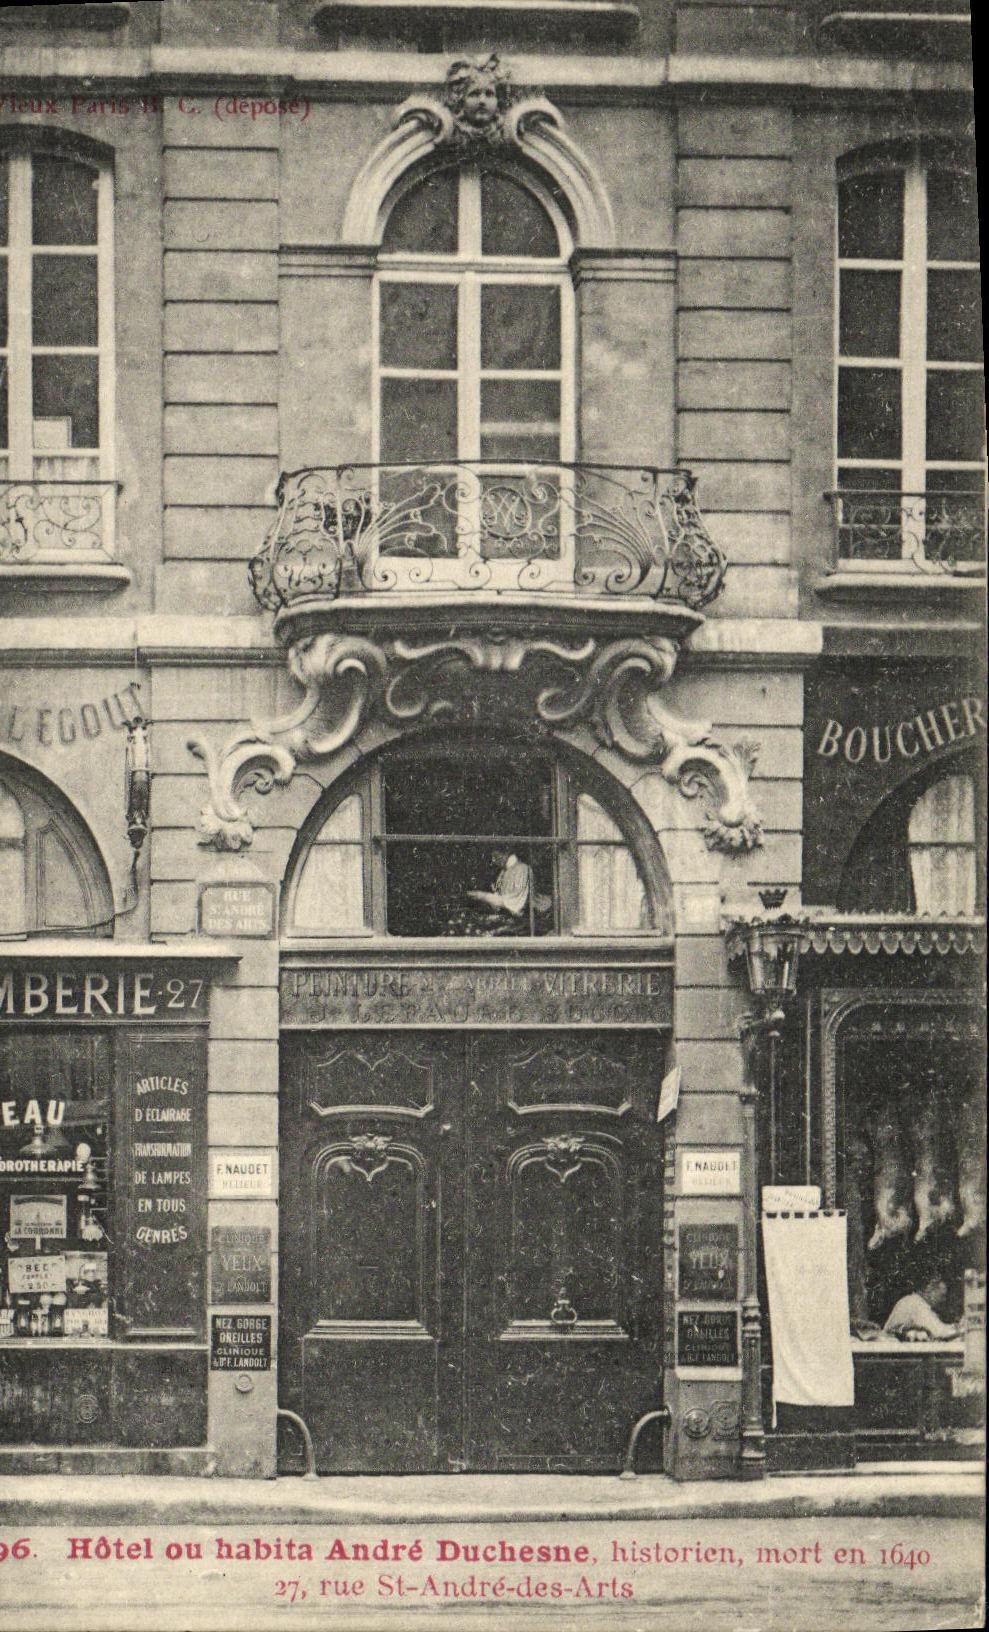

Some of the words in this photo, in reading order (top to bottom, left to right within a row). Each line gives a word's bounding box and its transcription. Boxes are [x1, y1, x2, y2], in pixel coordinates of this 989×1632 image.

[291, 972, 410, 997] PEINTURE
[543, 971, 661, 997] VITRERIE
[166, 978, 203, 1008] 27
[136, 1076, 189, 1095] ARTICLES
[134, 1171, 147, 1184] DE
[151, 1171, 191, 1184] LAMPES
[138, 1199, 152, 1212] EN
[156, 1199, 186, 1212] TOUS
[136, 1225, 188, 1244] GENRES
[221, 1254, 263, 1271] YEUX
[215, 1318, 233, 1329] NEZ
[236, 1318, 268, 1330] GORGE
[220, 1332, 263, 1343] OREILLES
[217, 1348, 264, 1356] CLINIQUE
[234, 1357, 268, 1368] LANDOLT
